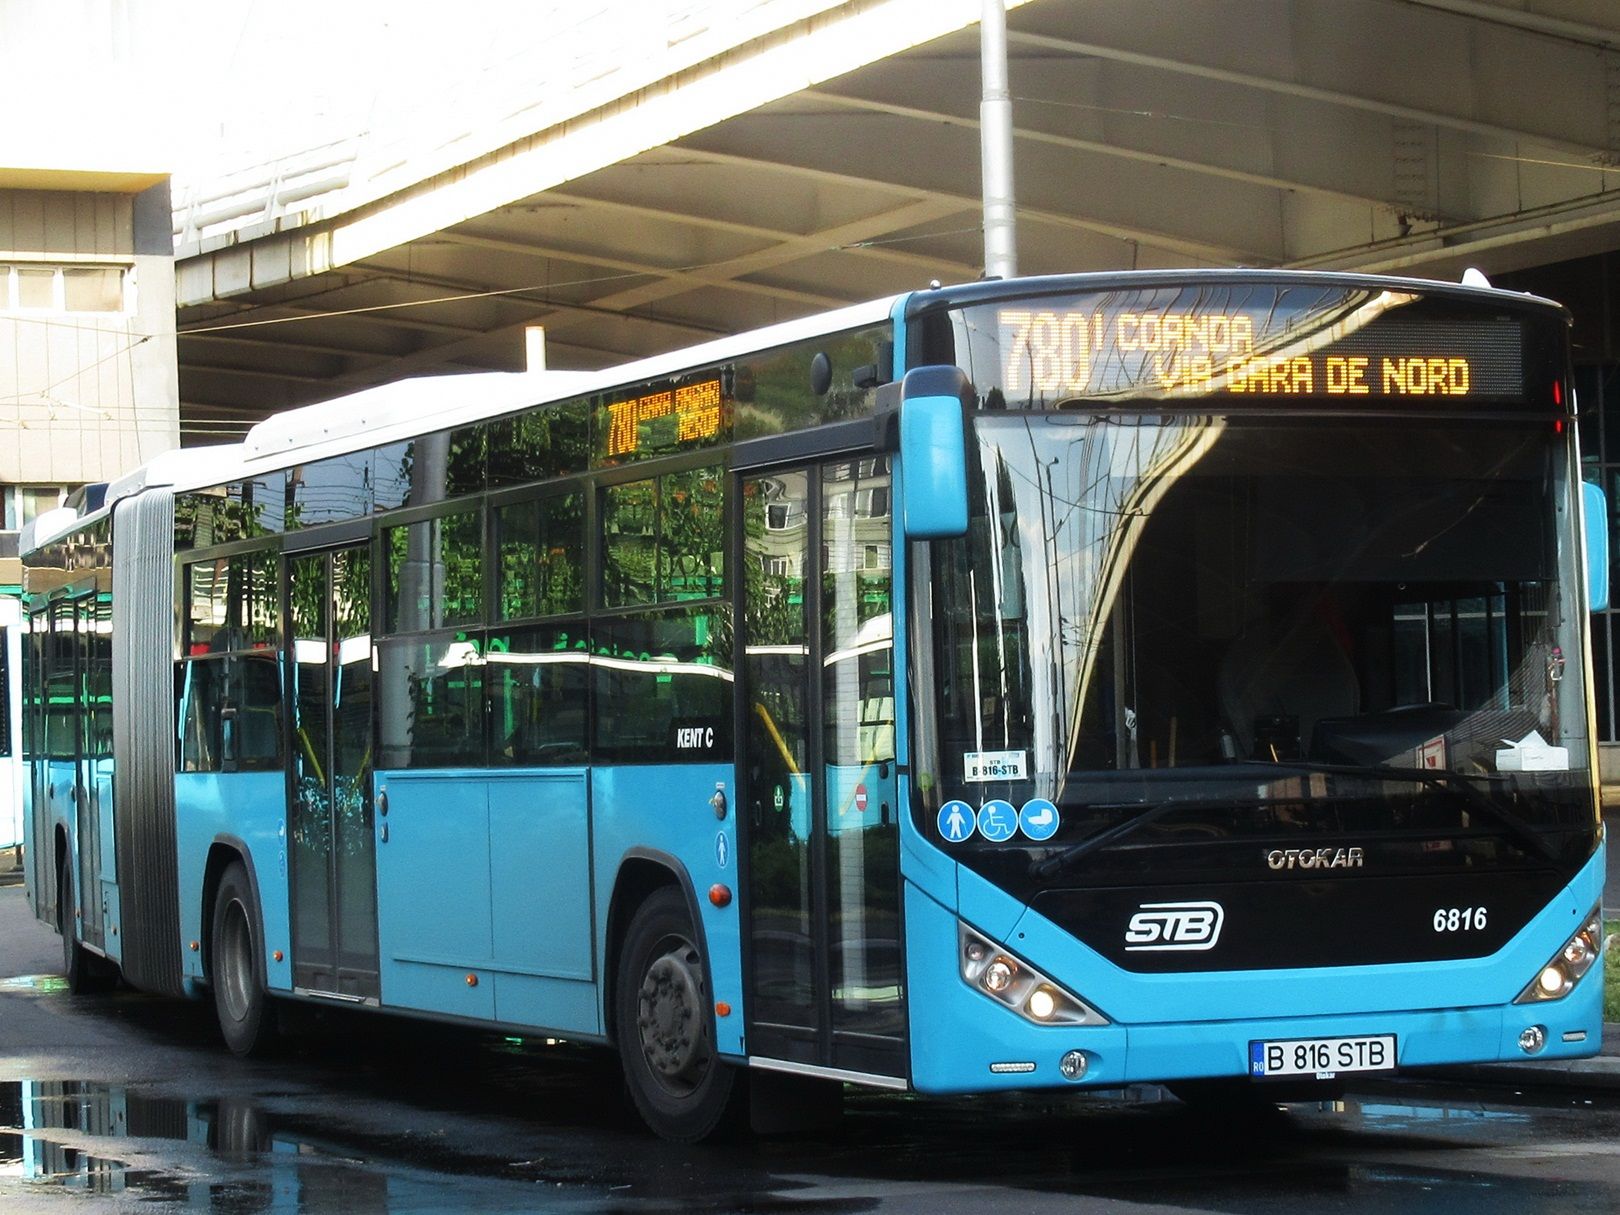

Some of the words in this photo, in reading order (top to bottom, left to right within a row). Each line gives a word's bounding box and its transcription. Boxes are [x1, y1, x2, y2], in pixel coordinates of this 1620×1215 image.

[1000, 311, 1090, 391] 780
[1116, 314, 1252, 352] COANDA
[1155, 355, 1213, 392] VIA
[1227, 357, 1313, 394] GARA
[1326, 357, 1370, 394] DE
[1383, 358, 1470, 395] NORD
[607, 399, 637, 456] 780
[677, 728, 704, 748] KENT
[705, 727, 714, 748] C
[1267, 847, 1364, 870] OTOKAR
[1125, 908, 1217, 944] STB
[1432, 906, 1488, 932] 6816
[1267, 1045, 1284, 1071] B
[1294, 1043, 1330, 1070] 816
[1337, 1041, 1385, 1068] STB
